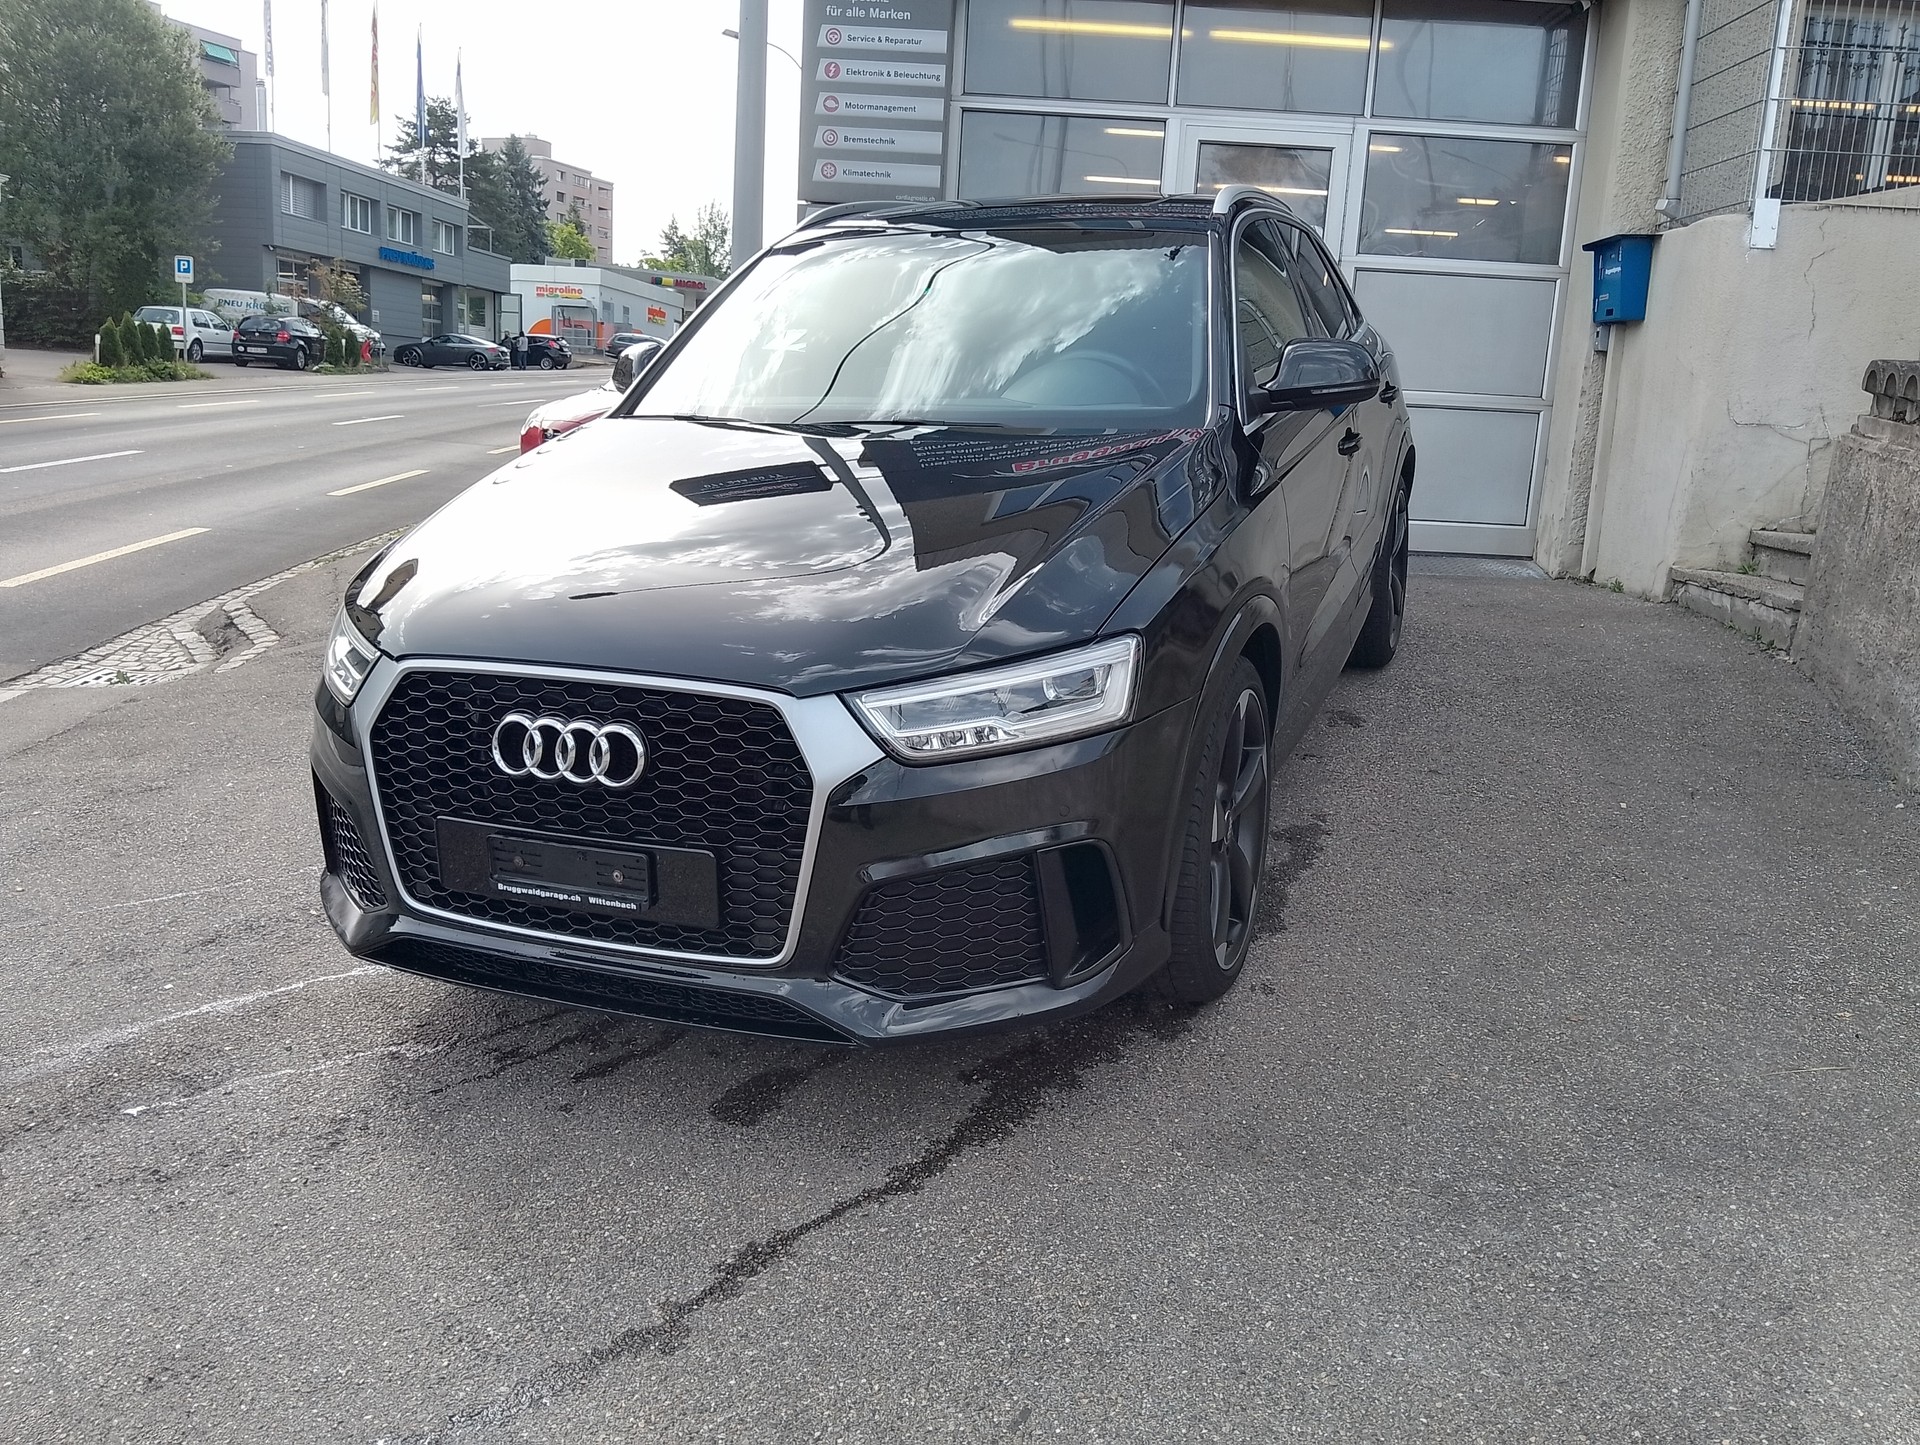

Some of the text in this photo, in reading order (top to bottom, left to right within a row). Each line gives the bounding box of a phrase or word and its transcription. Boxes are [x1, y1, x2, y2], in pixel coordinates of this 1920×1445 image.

[825, 5, 911, 20] für alle Marken
[847, 34, 922, 47] Service & Reparatur
[846, 68, 941, 82] Elektronik & Beleuchtung
[844, 101, 917, 113] Motormanagement
[843, 135, 896, 145] Bremstechnik
[842, 168, 892, 179] Klimatechnik
[180, 260, 189, 272] P
[535, 283, 583, 296] migrolino
[675, 278, 707, 290] MIGROL
[217, 298, 243, 308] PNEU
[497, 882, 638, 911] Bruggwaldgarage.ch Wittenbach
